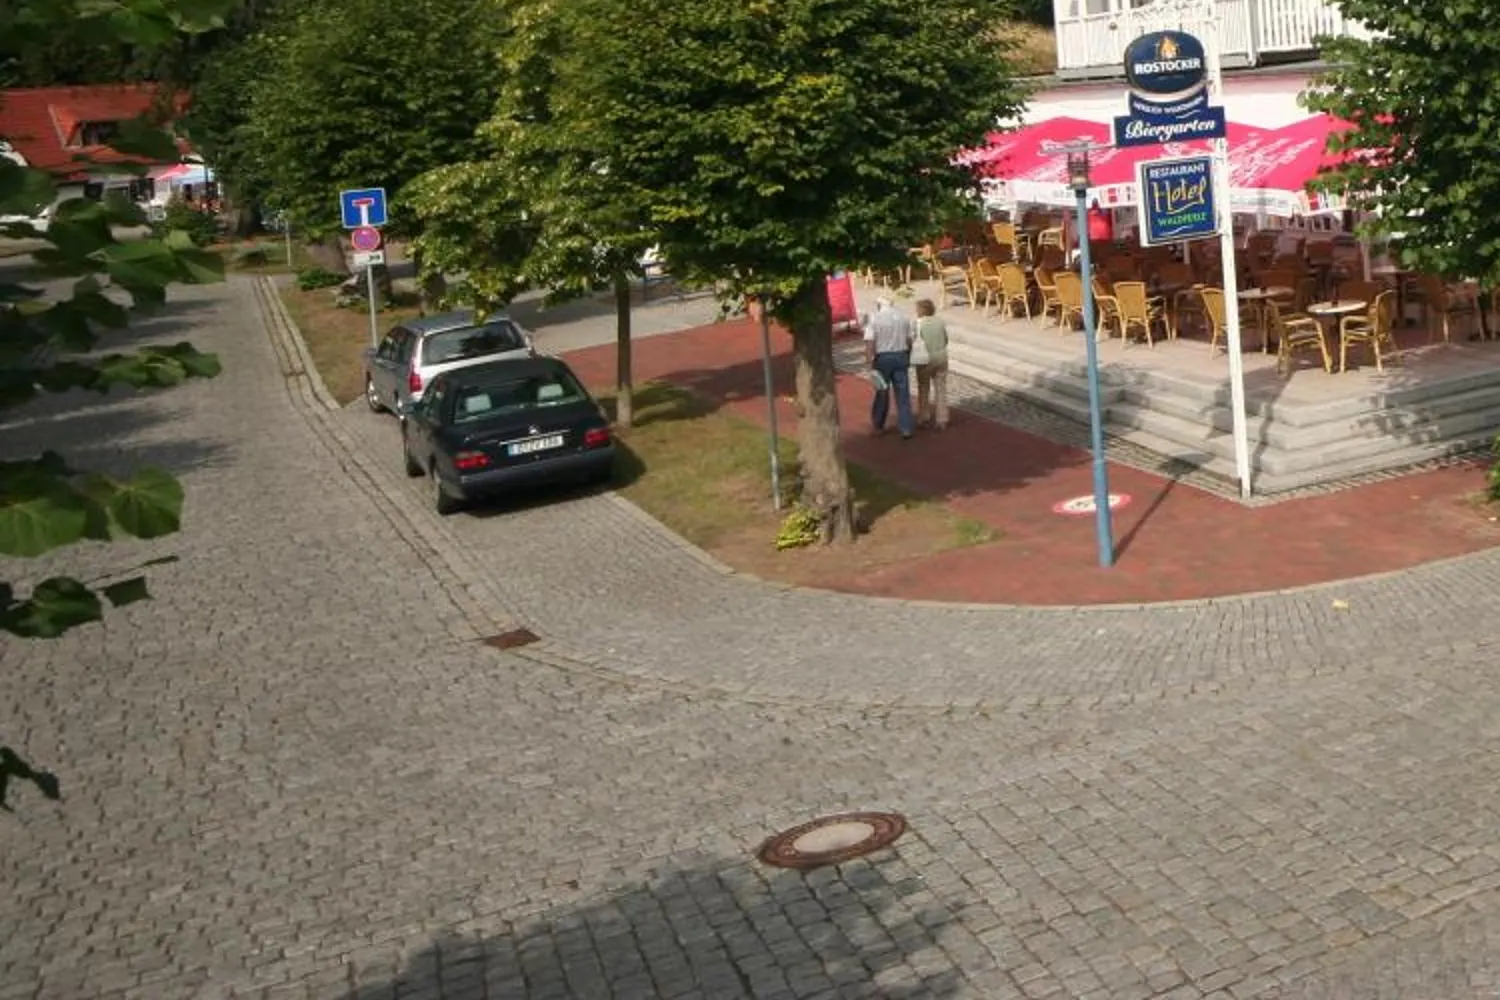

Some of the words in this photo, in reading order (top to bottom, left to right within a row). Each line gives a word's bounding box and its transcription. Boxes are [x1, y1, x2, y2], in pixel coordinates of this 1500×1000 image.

[1135, 58, 1200, 75] ROSTOCKER
[1125, 119, 1215, 141] Biergarten
[1150, 163, 1205, 179] RESTAURANT
[1150, 176, 1206, 213] Hotel
